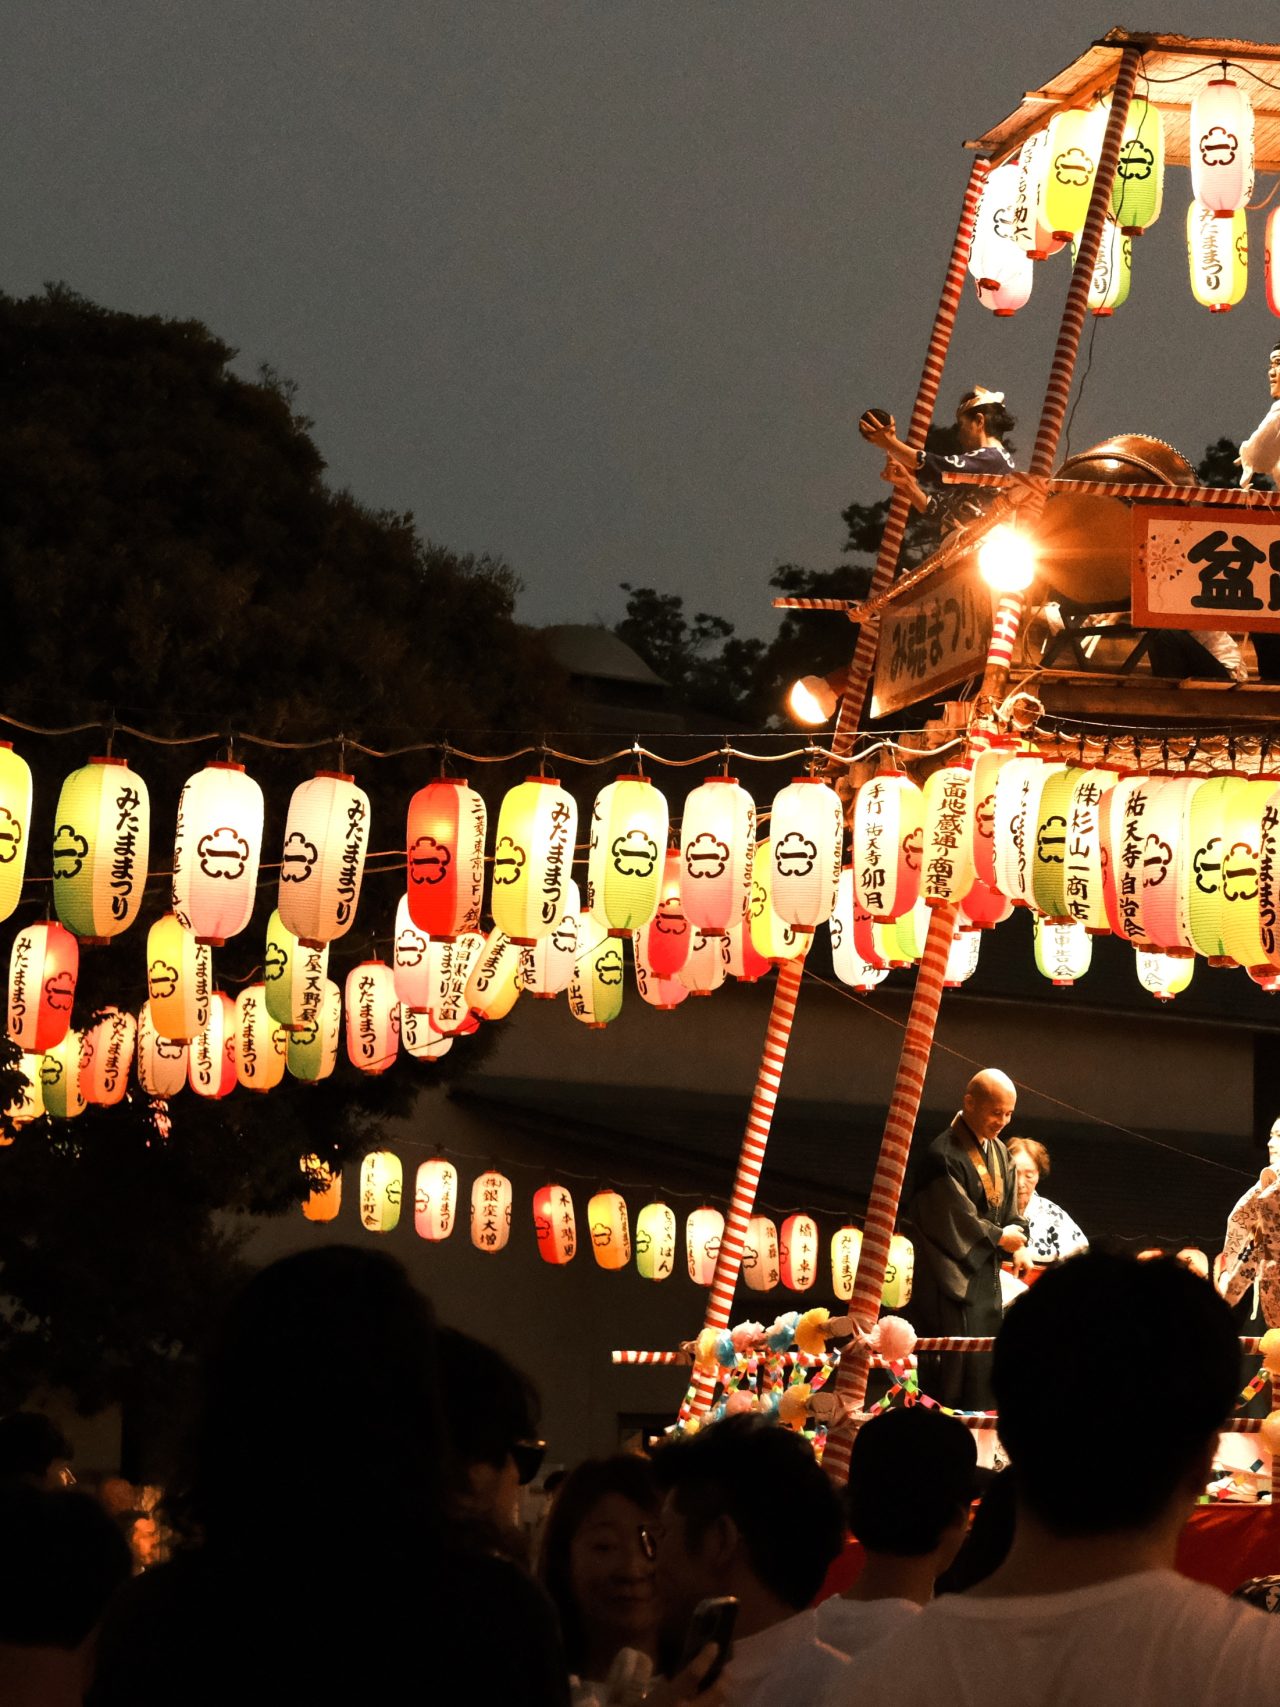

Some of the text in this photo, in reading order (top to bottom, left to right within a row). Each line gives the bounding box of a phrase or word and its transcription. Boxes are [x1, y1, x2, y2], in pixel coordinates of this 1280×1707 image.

[1197, 207, 1223, 291] みたままつり
[109, 786, 141, 922] みたままつり
[335, 798, 368, 926] みたままつり
[540, 801, 571, 925] みたままつり
[1119, 789, 1149, 938] 祐天寺自治会
[1259, 805, 1280, 955] みたままつり
[11, 936, 33, 1036] みたままつり
[240, 997, 257, 1078] みたままつり
[357, 975, 377, 1060] みたままつり
[103, 1017, 128, 1093] みたままつり
